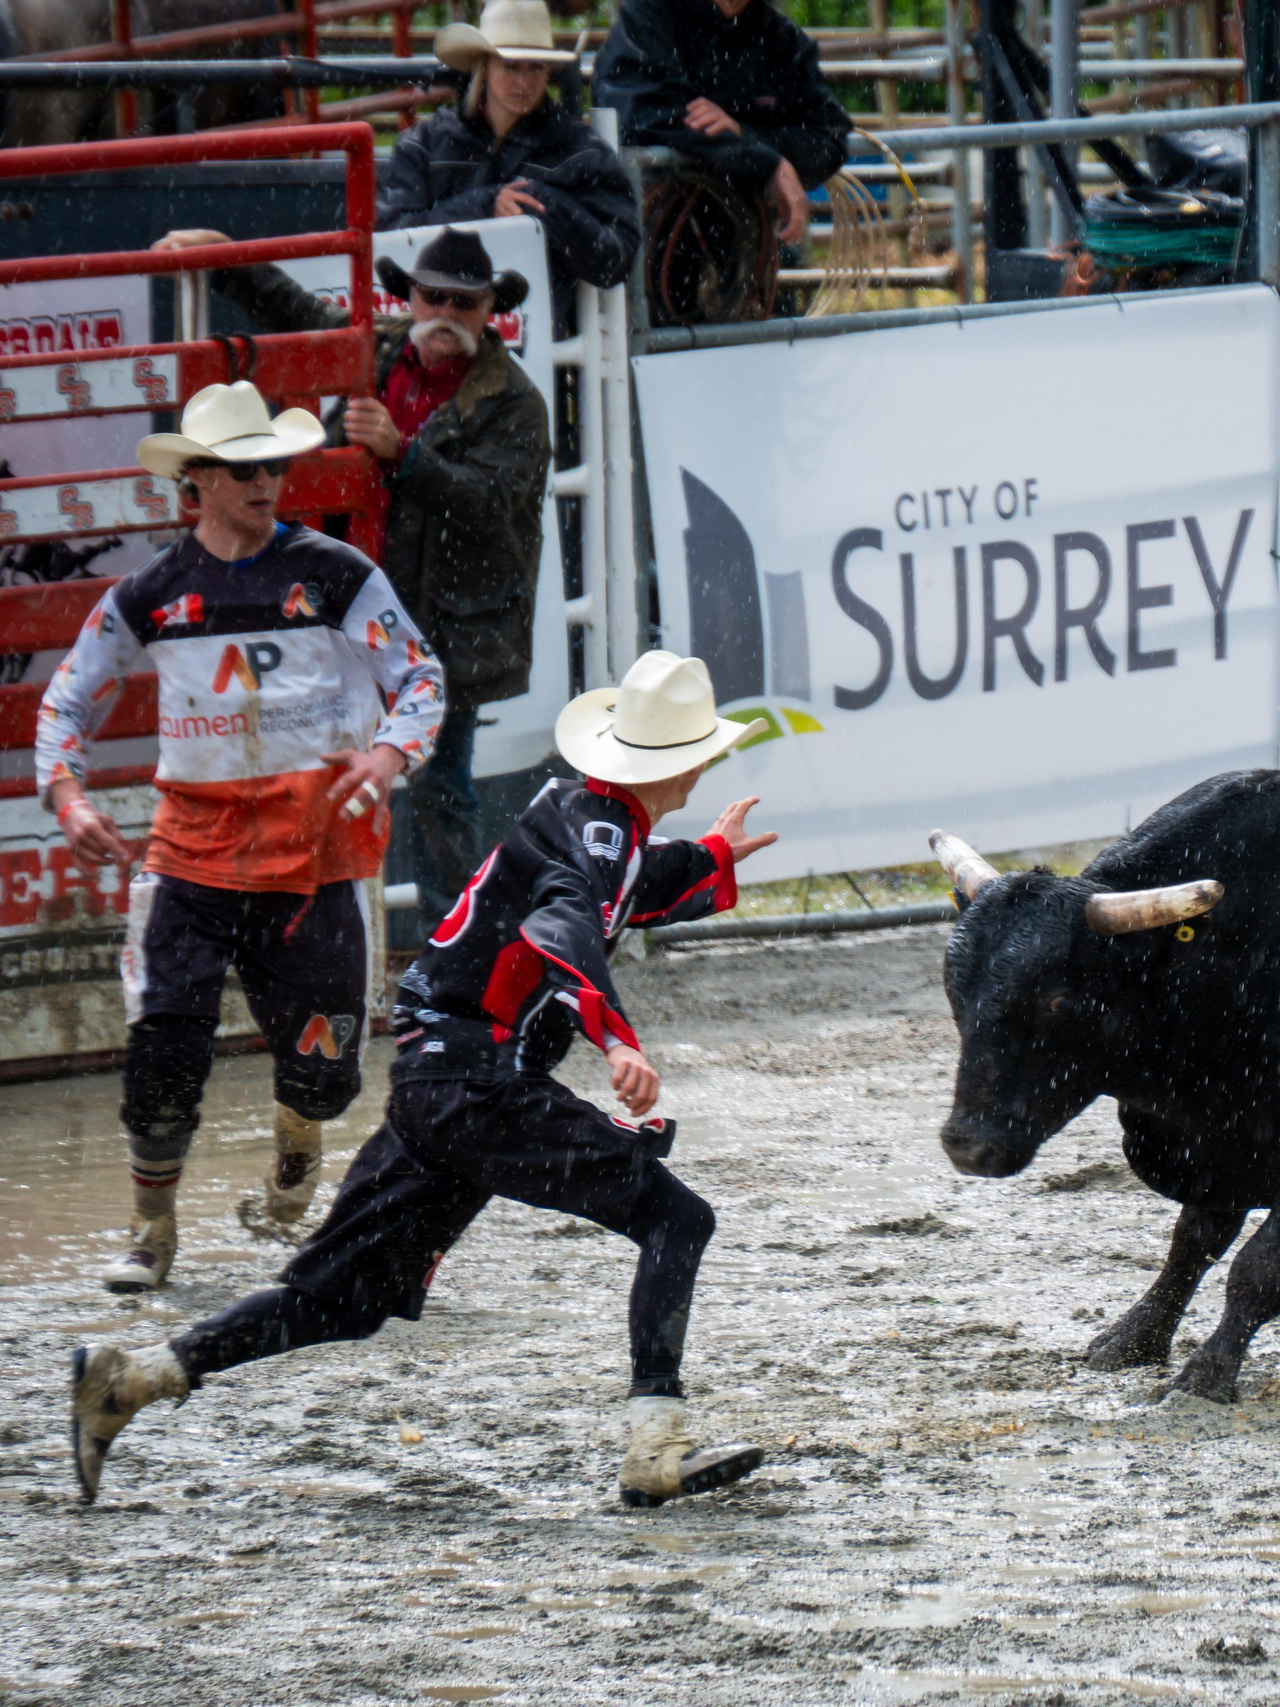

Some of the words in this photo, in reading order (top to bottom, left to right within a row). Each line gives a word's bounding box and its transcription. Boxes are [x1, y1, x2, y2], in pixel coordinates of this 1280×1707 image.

[894, 484, 979, 532] CITY
[994, 477, 1039, 521] OF
[830, 508, 1256, 711] SURREY
